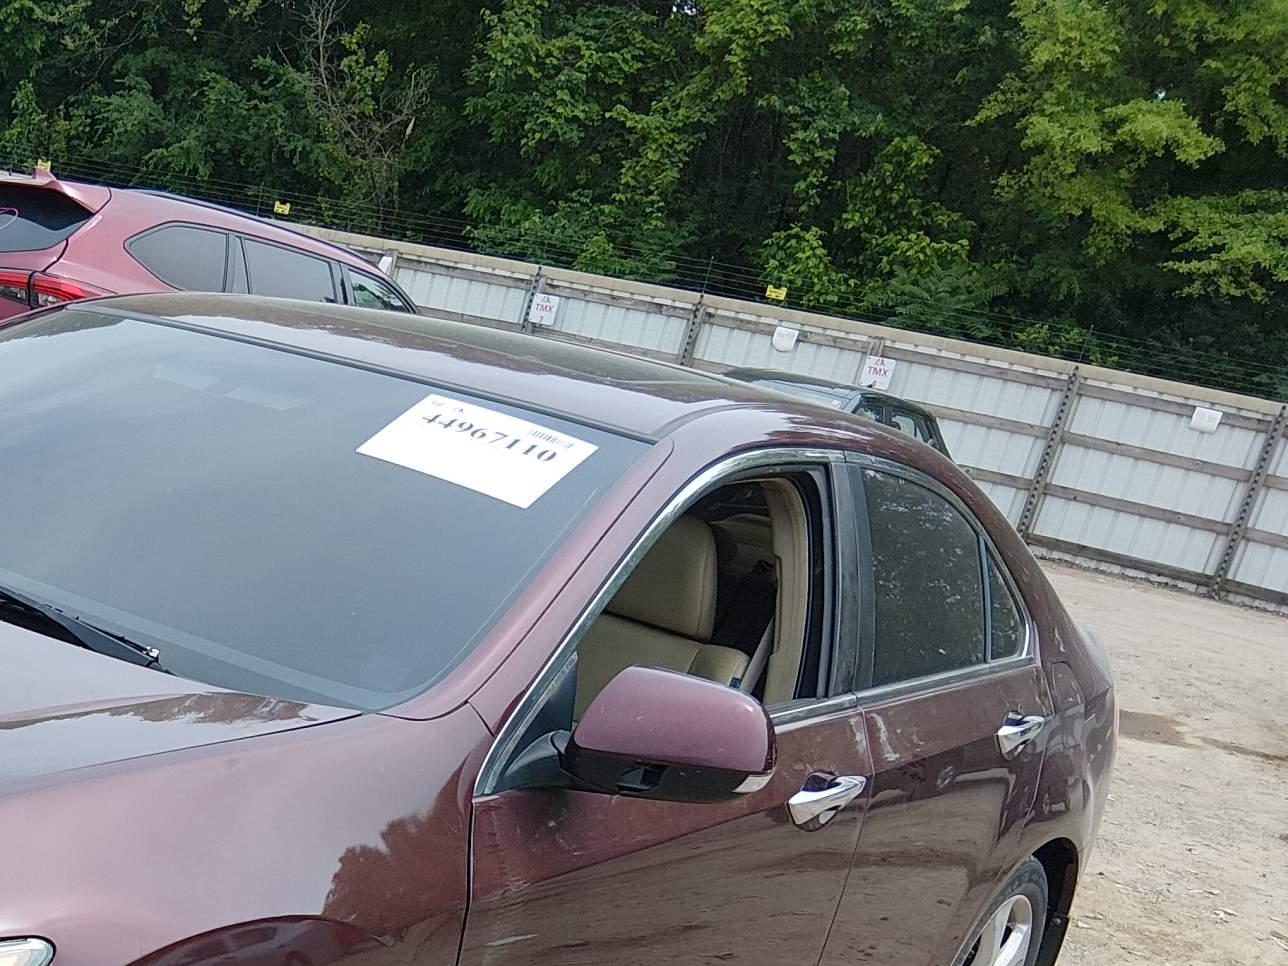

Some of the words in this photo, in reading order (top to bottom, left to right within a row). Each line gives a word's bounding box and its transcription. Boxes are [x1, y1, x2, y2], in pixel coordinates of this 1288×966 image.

[535, 303, 553, 313] TMX
[868, 366, 889, 378] TMX
[421, 413, 557, 462] 44967110
